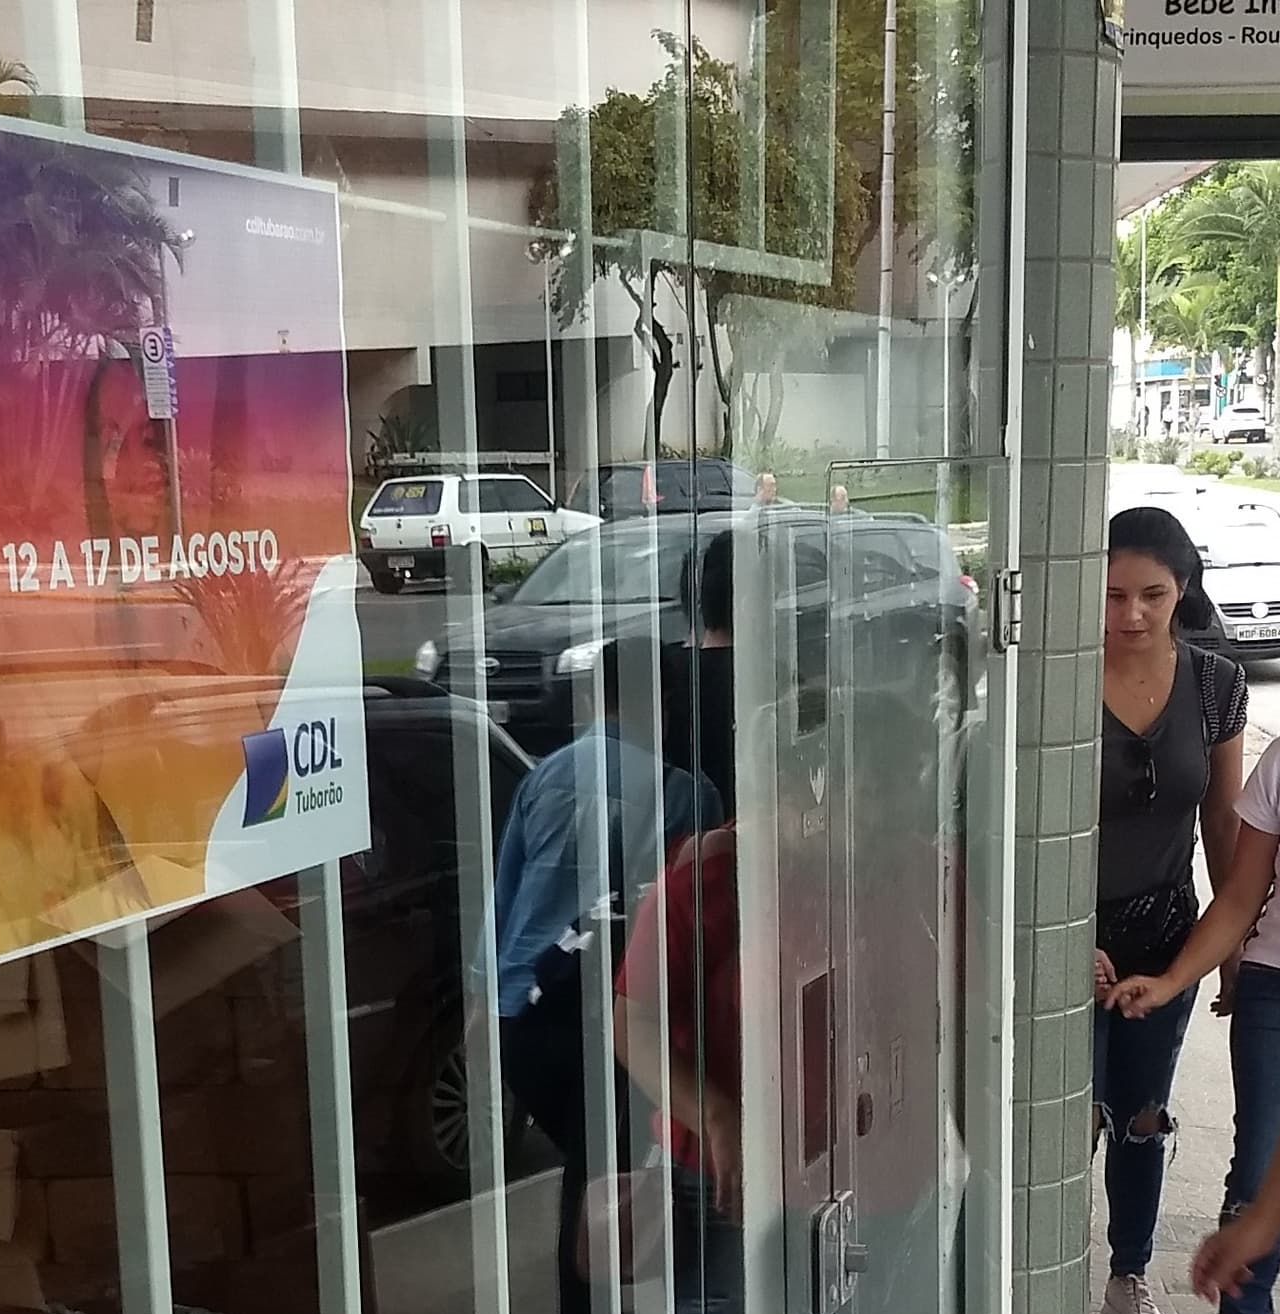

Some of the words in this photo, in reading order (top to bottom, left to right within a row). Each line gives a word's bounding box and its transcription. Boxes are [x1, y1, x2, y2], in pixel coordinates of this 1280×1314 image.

[1122, 28, 1222, 48] rinquedos
[2, 541, 40, 593] 12
[49, 540, 75, 590] A
[80, 538, 111, 586] 17
[120, 536, 161, 584] DE
[169, 529, 278, 580] AGOSTO
[293, 717, 342, 777] CDL
[295, 782, 343, 814] Tubarão
